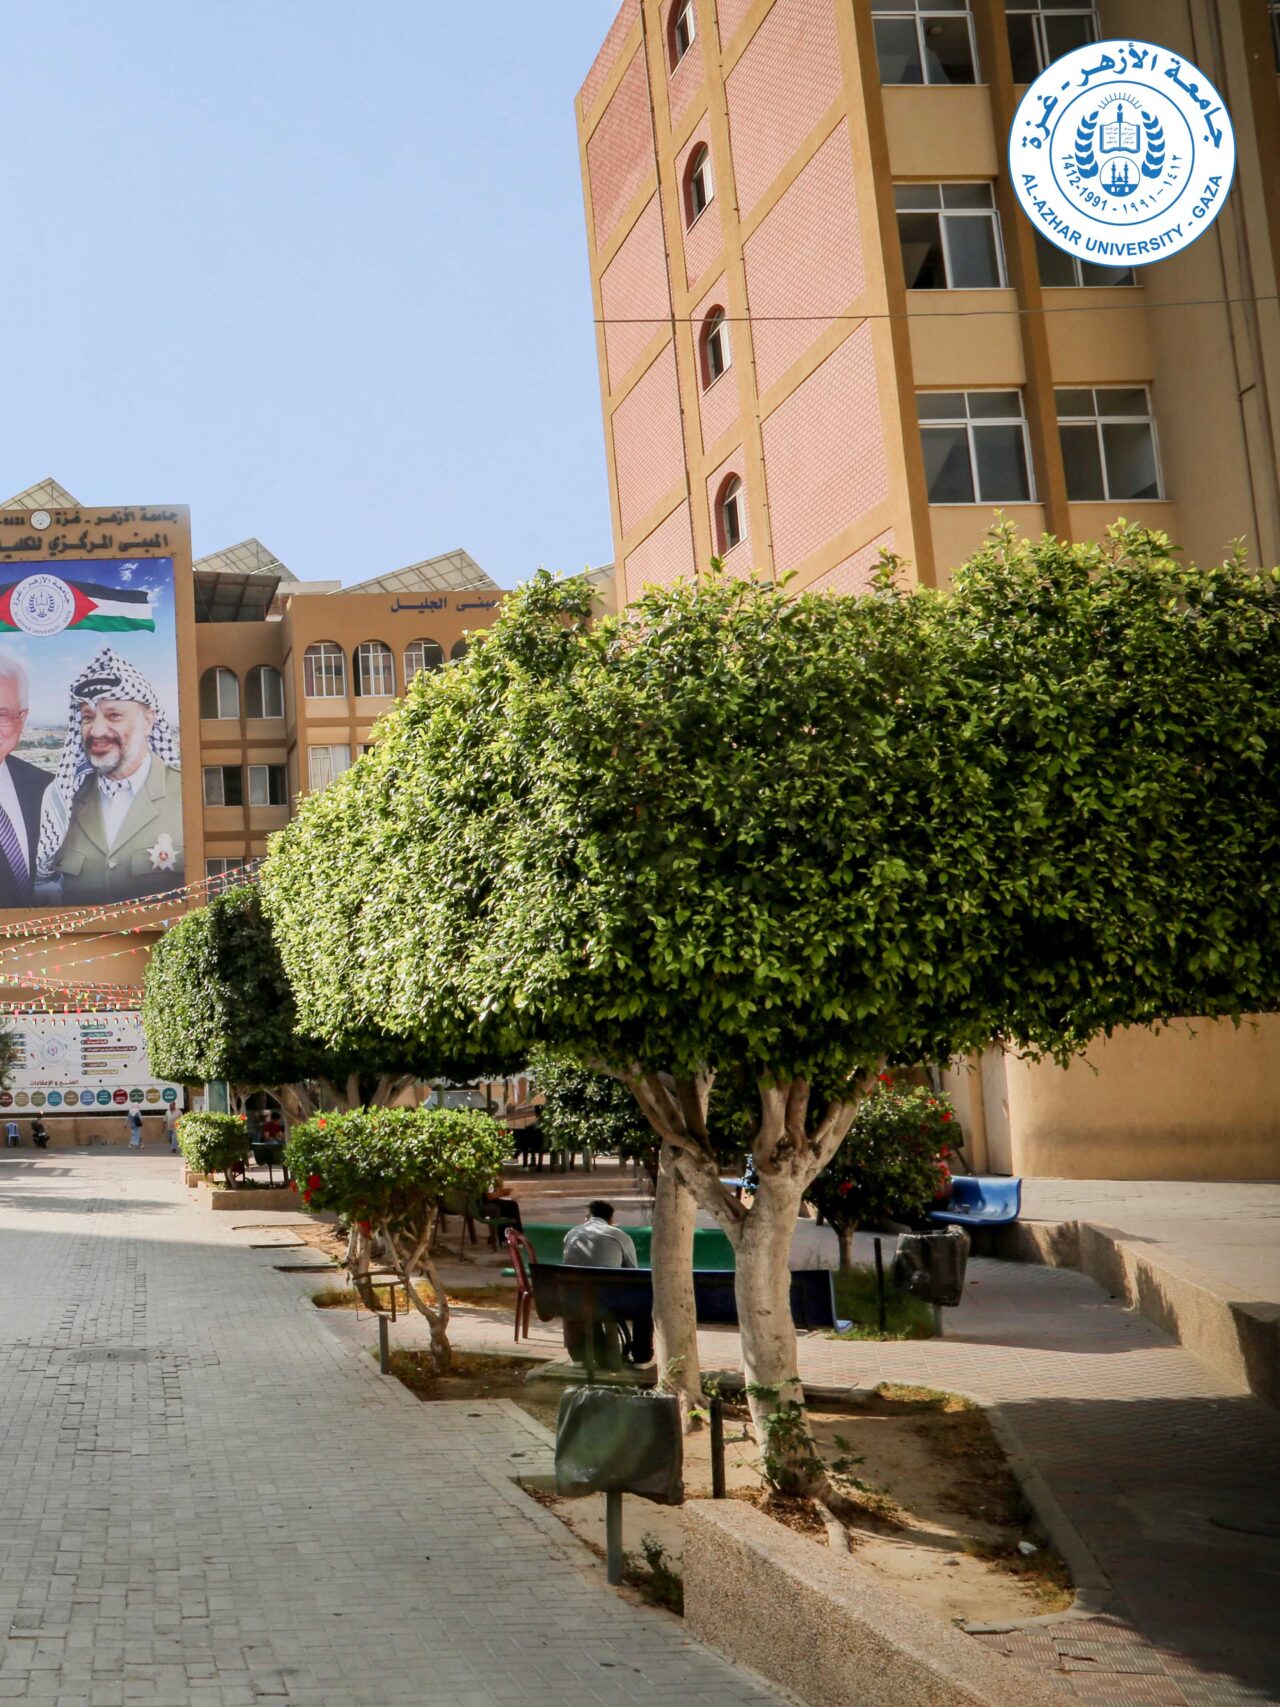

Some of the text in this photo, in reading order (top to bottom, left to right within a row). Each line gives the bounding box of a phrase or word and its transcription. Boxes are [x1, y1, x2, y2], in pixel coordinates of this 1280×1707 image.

[3, 516, 25, 526] GAZA
[55, 511, 81, 526] غزة
[140, 507, 178, 524] جامعة
[48, 529, 113, 557] المركزي
[391, 596, 447, 613] الجليل
